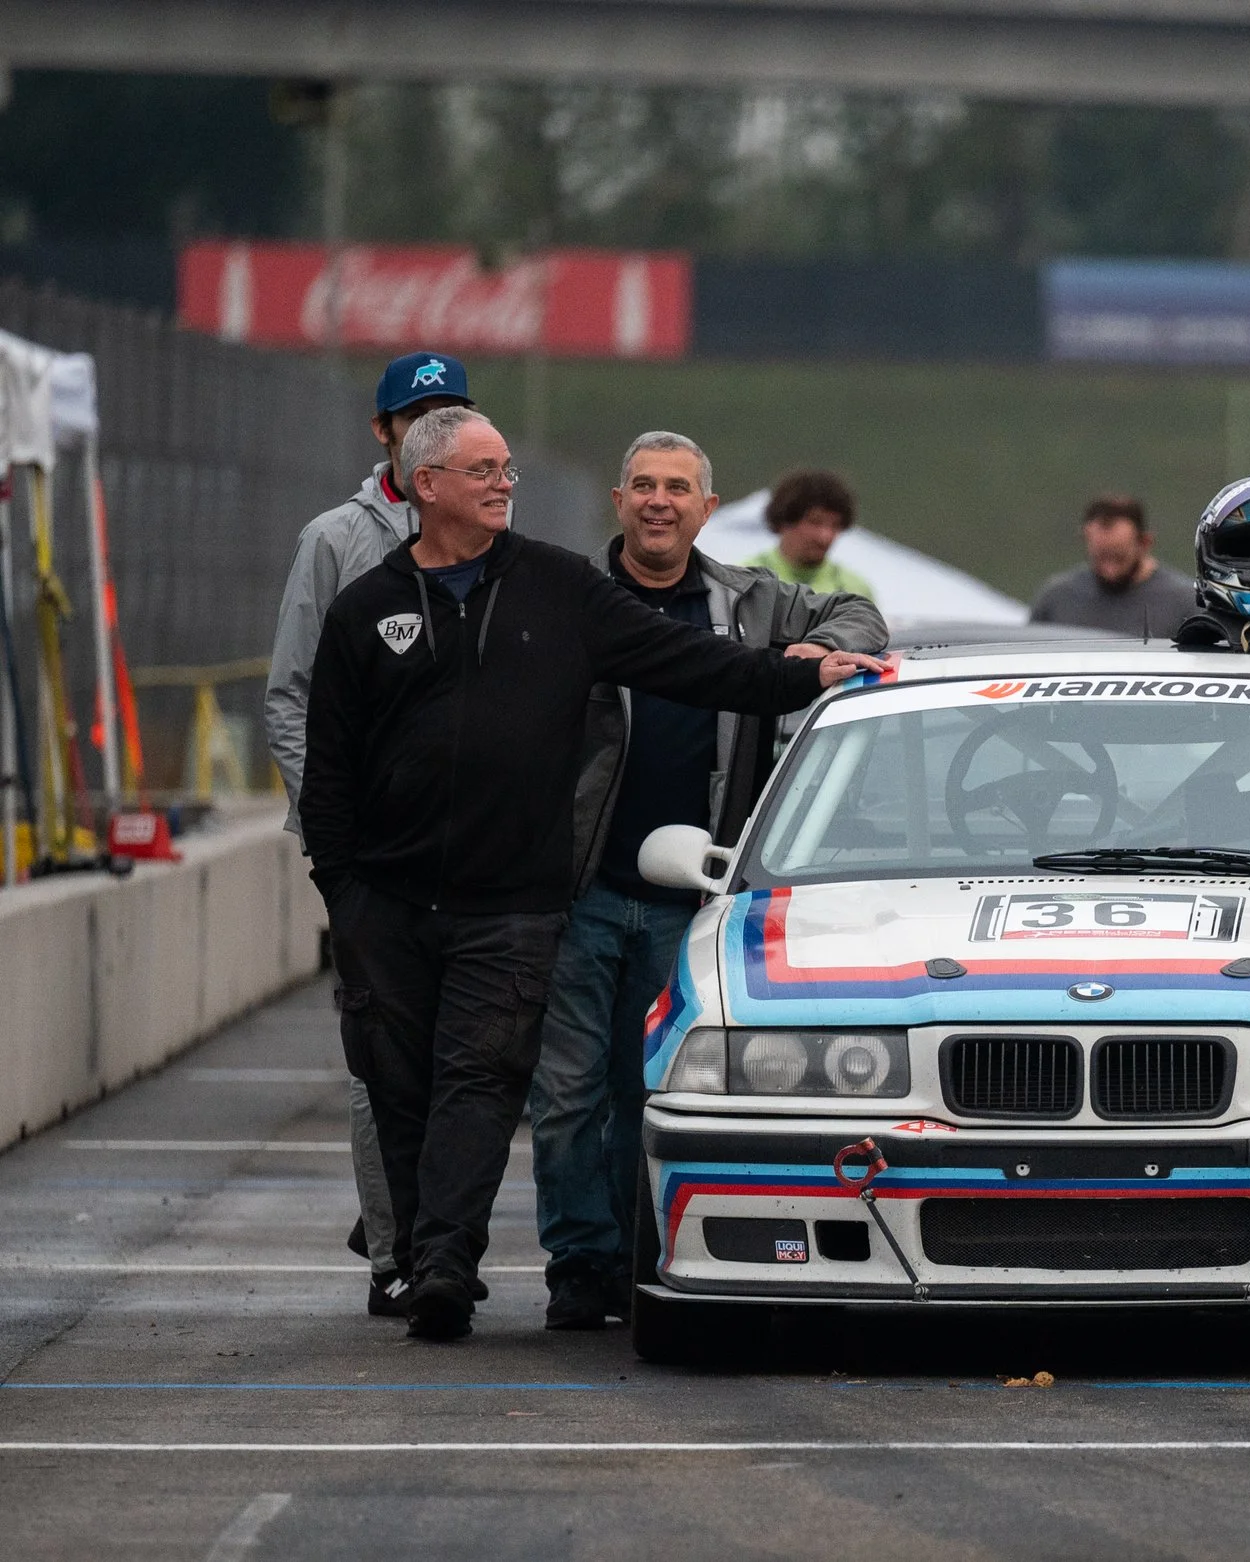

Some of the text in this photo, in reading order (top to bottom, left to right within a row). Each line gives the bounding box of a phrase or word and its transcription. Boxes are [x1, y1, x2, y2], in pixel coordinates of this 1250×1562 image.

[384, 620, 416, 641] BM
[1021, 902, 1147, 928] 36
[778, 1242, 803, 1252] LIQUI
